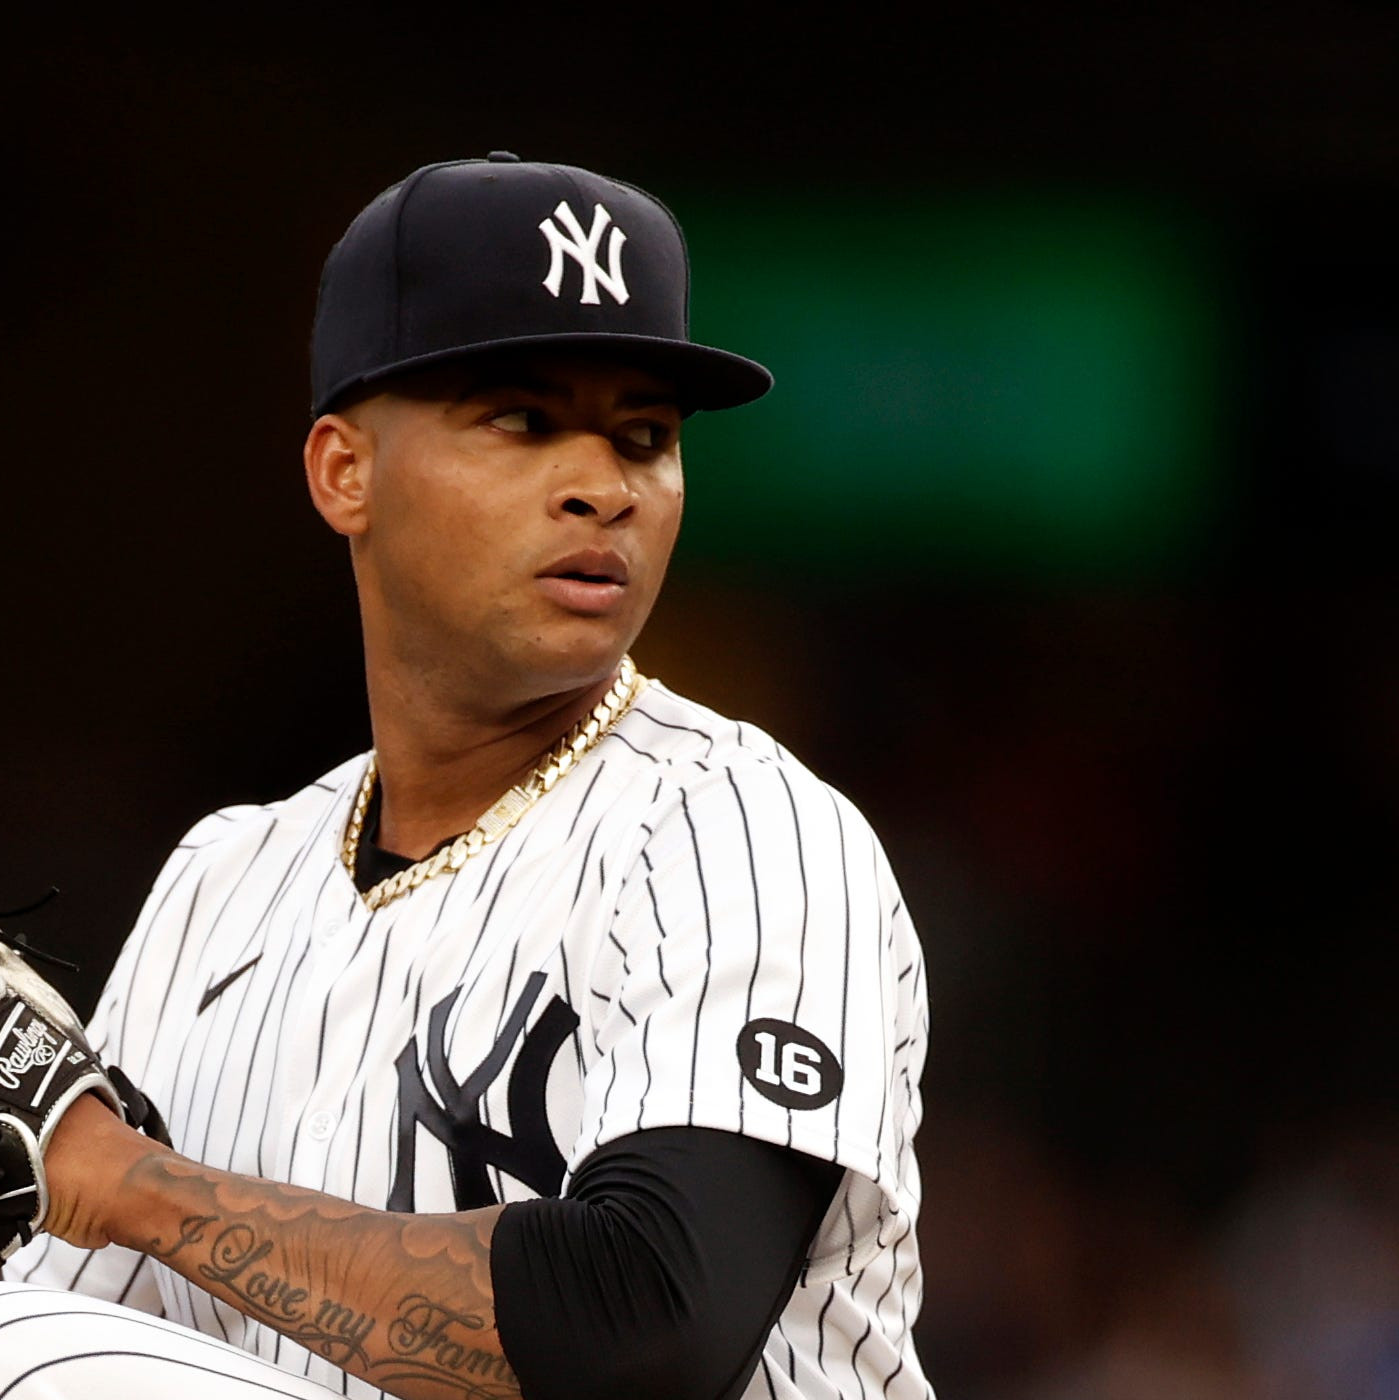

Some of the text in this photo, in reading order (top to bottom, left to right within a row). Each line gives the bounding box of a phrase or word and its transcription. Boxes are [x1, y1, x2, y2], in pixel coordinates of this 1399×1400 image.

[538, 200, 630, 305] NY
[386, 971, 581, 1214] NY
[754, 1031, 822, 1096] 16
[199, 1223, 310, 1321] Love
[302, 1299, 376, 1372] my
